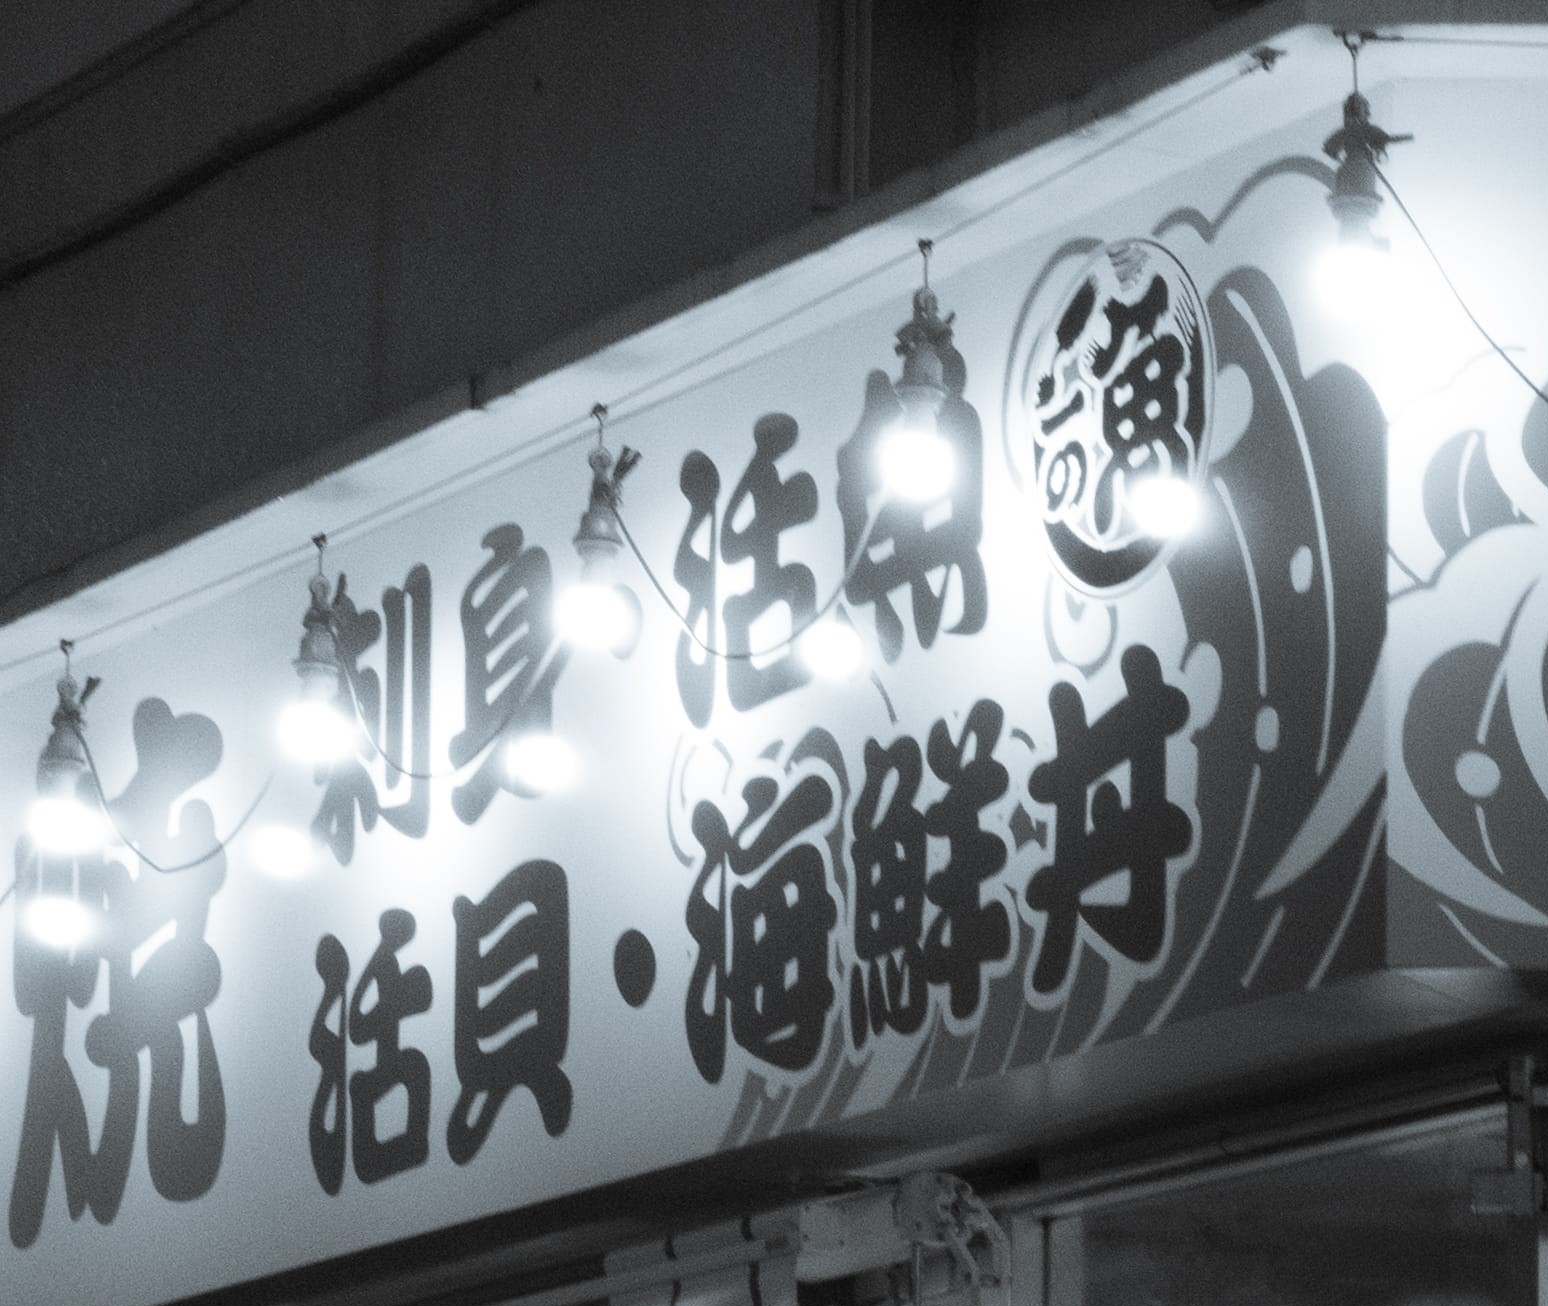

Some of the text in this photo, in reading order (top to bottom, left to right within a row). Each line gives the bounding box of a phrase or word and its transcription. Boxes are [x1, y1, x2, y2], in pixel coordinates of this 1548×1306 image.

[309, 644, 1194, 1197] 活貝・海鮮丼
